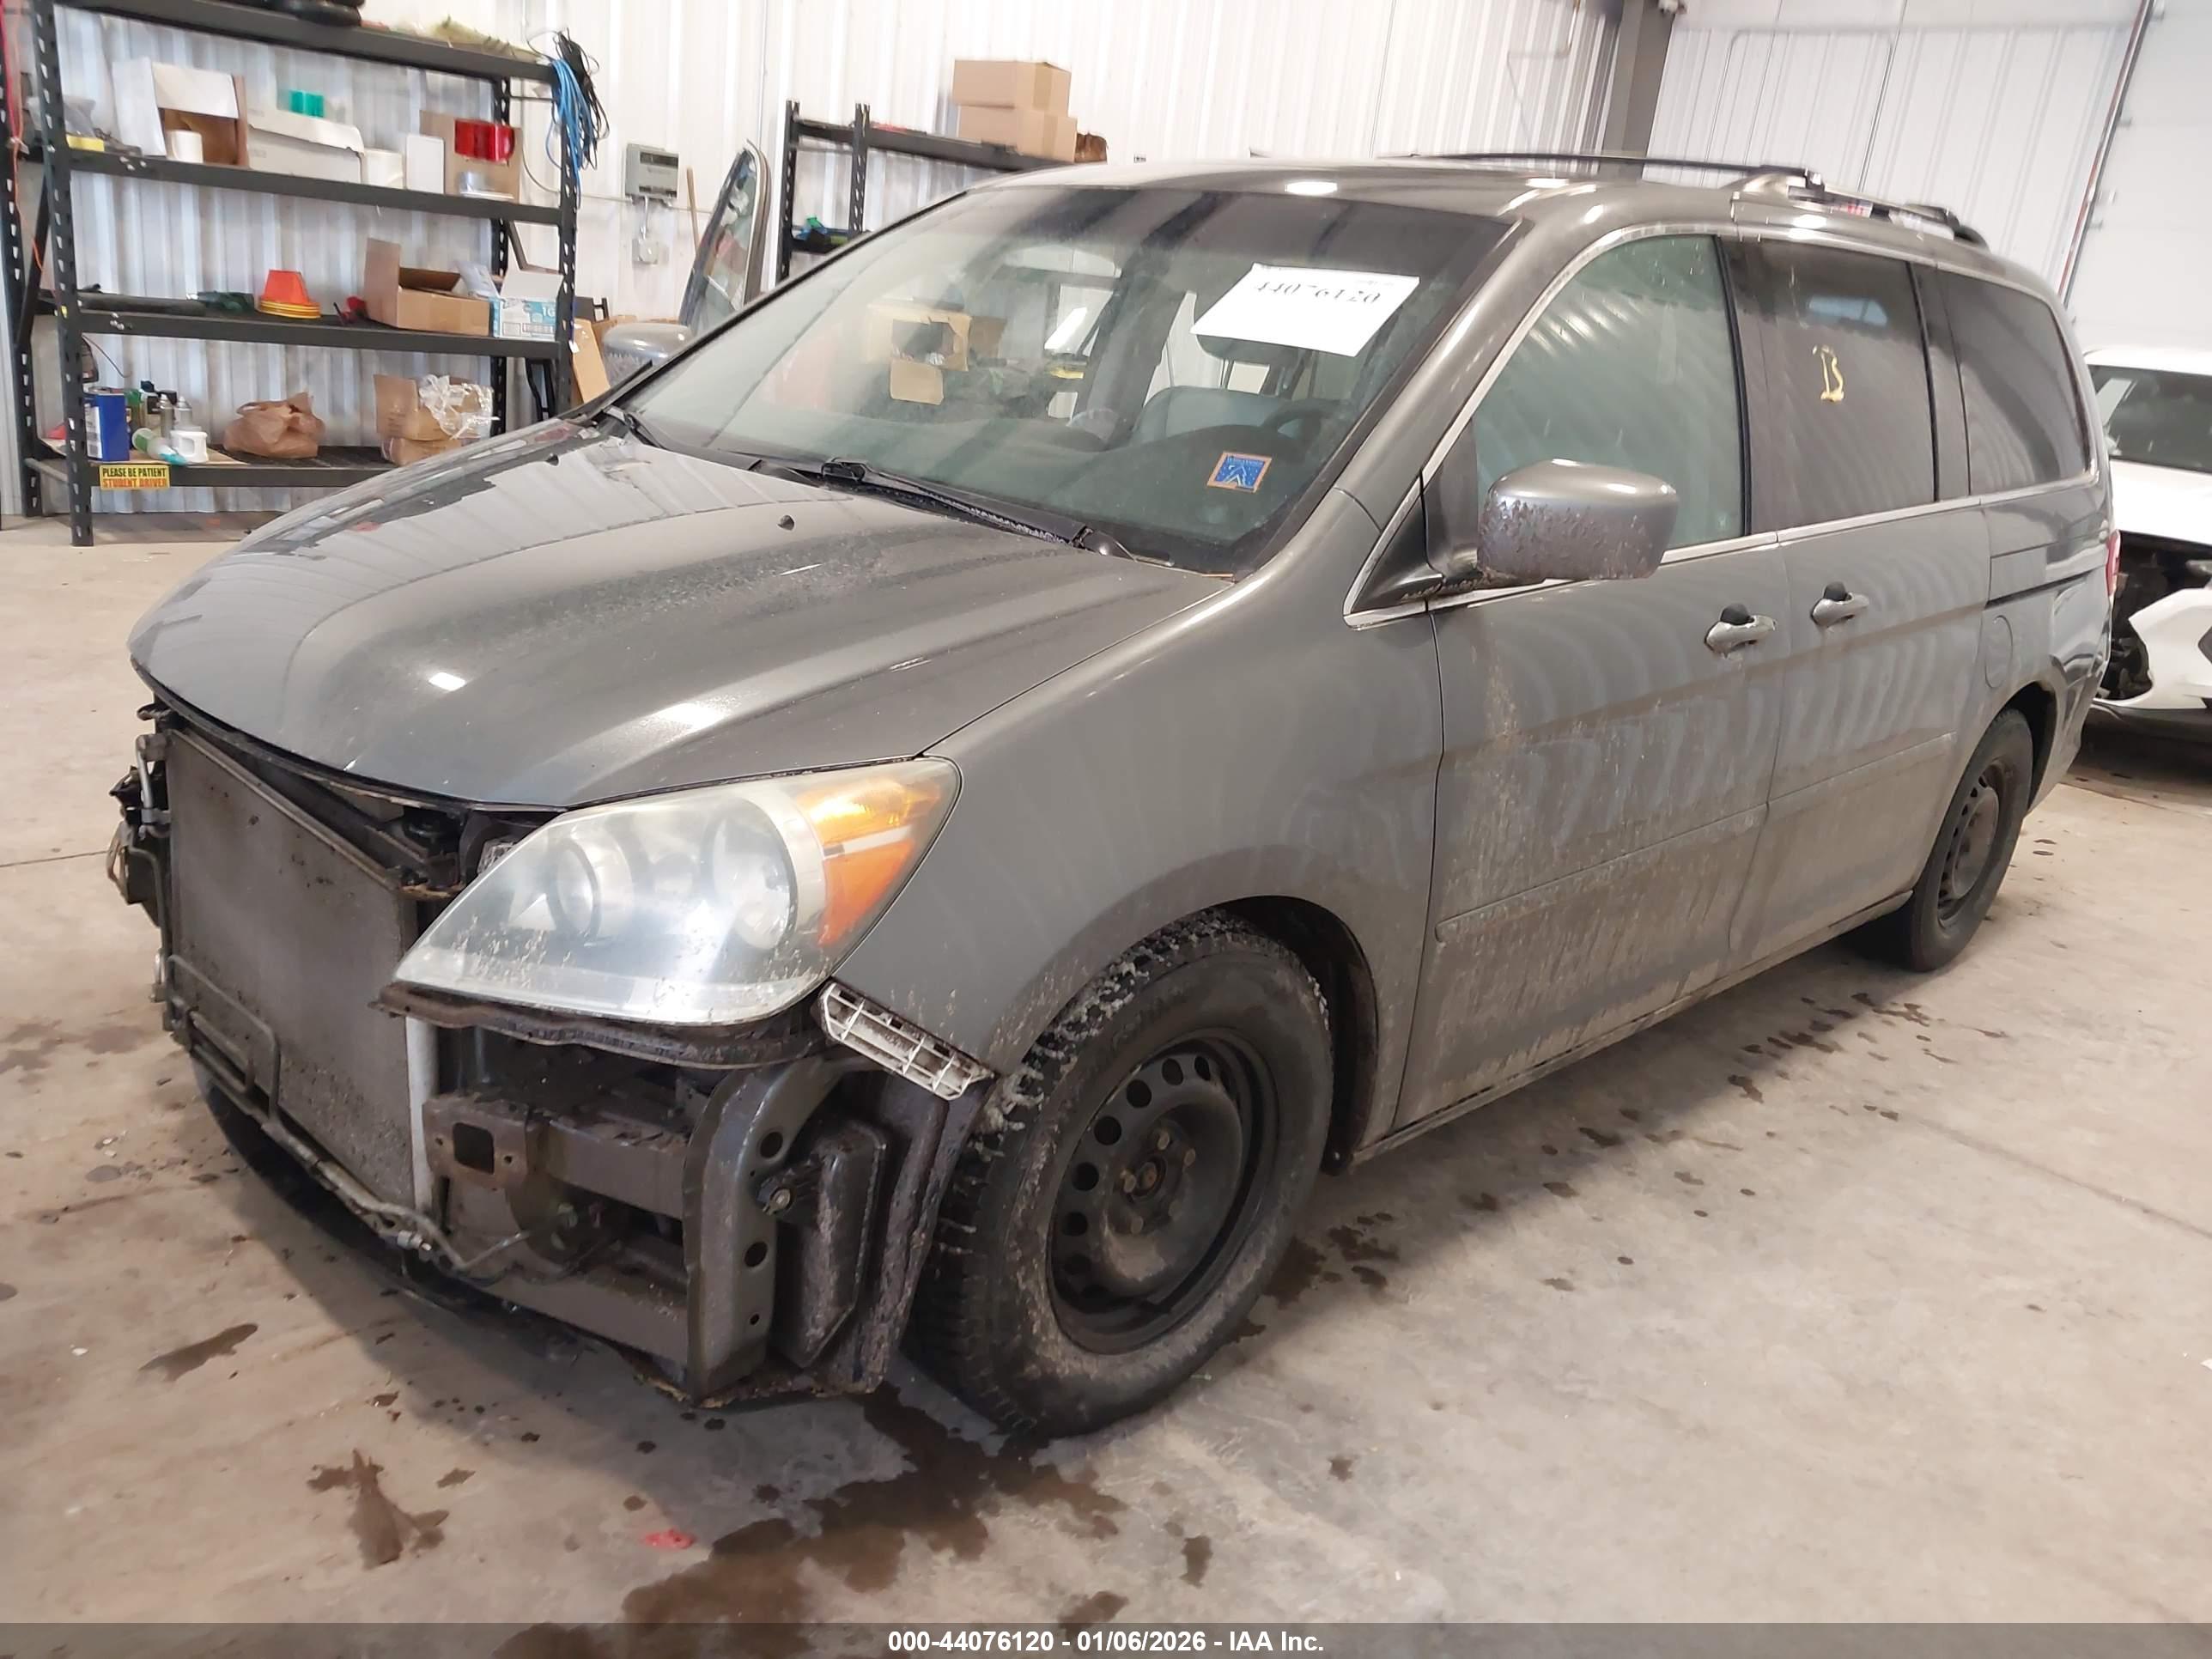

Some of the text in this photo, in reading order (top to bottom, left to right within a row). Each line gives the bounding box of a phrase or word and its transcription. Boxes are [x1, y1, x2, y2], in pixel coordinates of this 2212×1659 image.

[102, 467, 167, 477] PLEASE BE PATIENT
[102, 477, 137, 488] STUDENT
